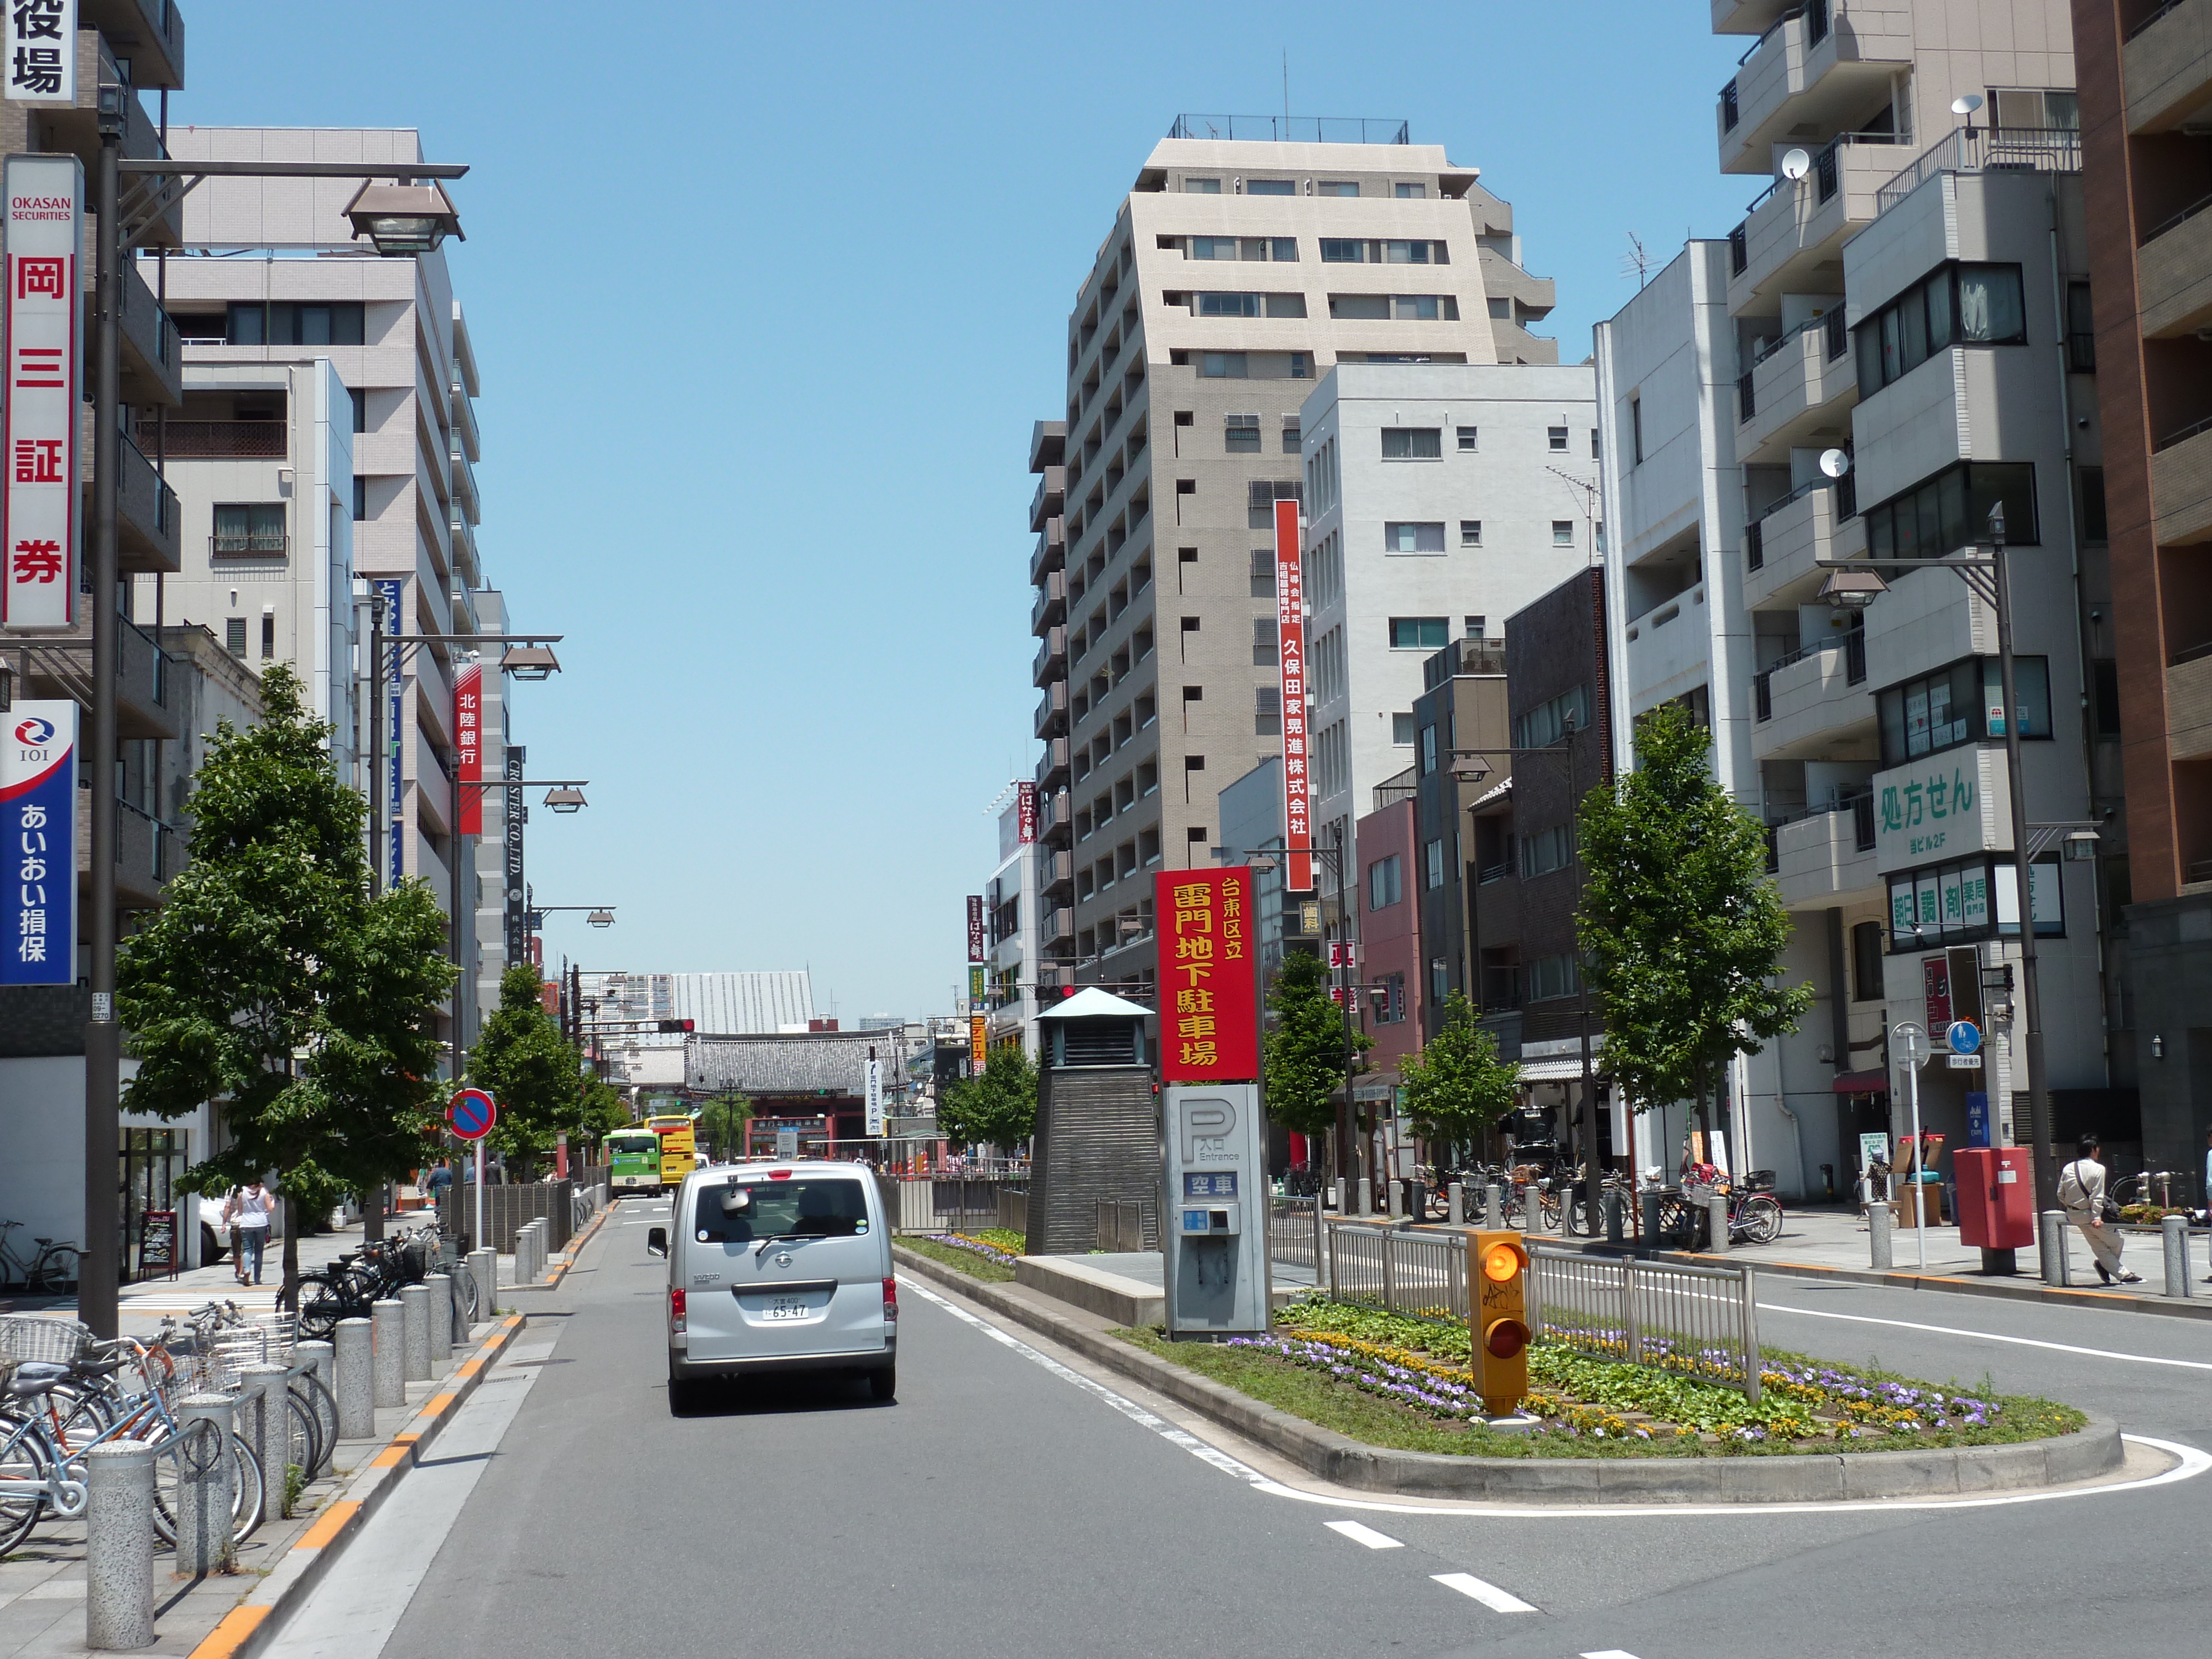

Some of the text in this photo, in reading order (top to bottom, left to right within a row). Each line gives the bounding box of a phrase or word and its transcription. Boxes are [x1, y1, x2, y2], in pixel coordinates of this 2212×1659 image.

[12, 197, 71, 209] OKASAN
[12, 212, 70, 221] SECURITIES
[13, 257, 65, 583] 岡三証券
[460, 693, 476, 764] 北陸銀行
[1284, 639, 1306, 834] 久保田家晃進株式会社
[20, 750, 49, 761] IOI
[1881, 767, 1972, 834] 処方せん
[19, 804, 46, 962] あいおい損保
[1893, 878, 1987, 928] 朝日調剤薬局
[1222, 877, 1244, 959] 台東区立
[1303, 907, 1318, 928] 歯科
[1173, 882, 1218, 1066] 雷門地下駐車場
[1180, 1099, 1236, 1163] P
[1199, 1139, 1224, 1151] 入口
[1199, 1152, 1239, 1161] Entrance
[1191, 1176, 1233, 1194] 空車
[773, 1305, 806, 1317] 65-47
